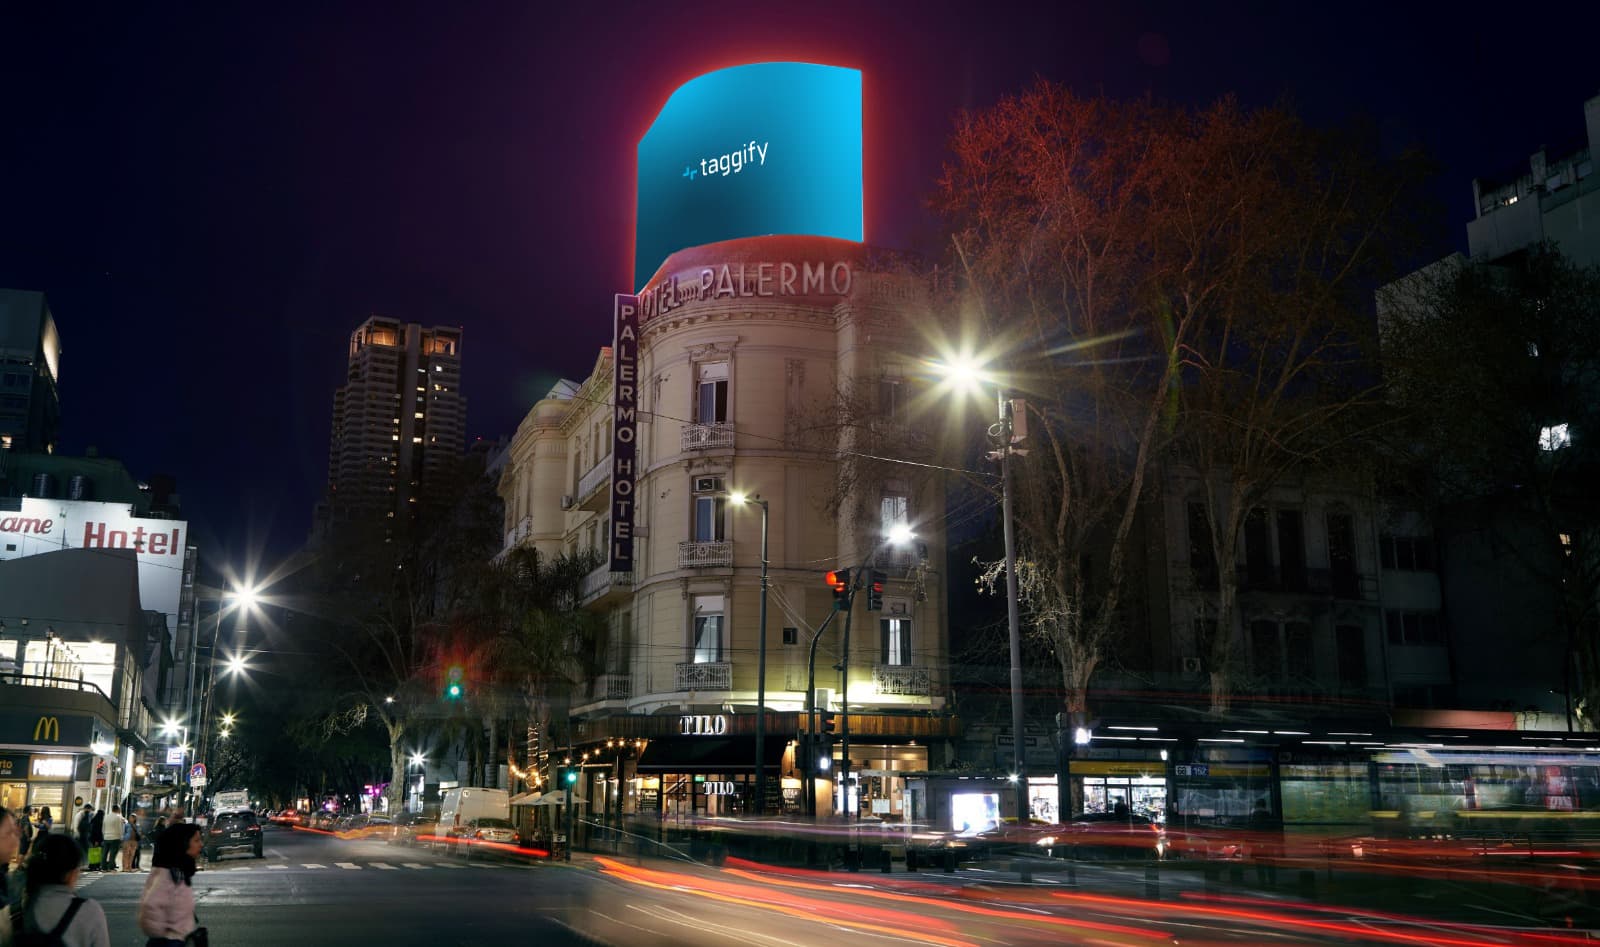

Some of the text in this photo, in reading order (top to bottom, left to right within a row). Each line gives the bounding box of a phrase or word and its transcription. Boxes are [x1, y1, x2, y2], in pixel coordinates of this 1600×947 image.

[700, 140, 769, 176] taggify
[638, 275, 681, 323] OTEL
[700, 262, 852, 299] PALERMO
[615, 304, 636, 560] PALERMO HOTEL
[0, 517, 53, 534] ame
[84, 522, 179, 555] Hotel
[679, 714, 726, 735] TILO
[703, 781, 734, 795] TILO
